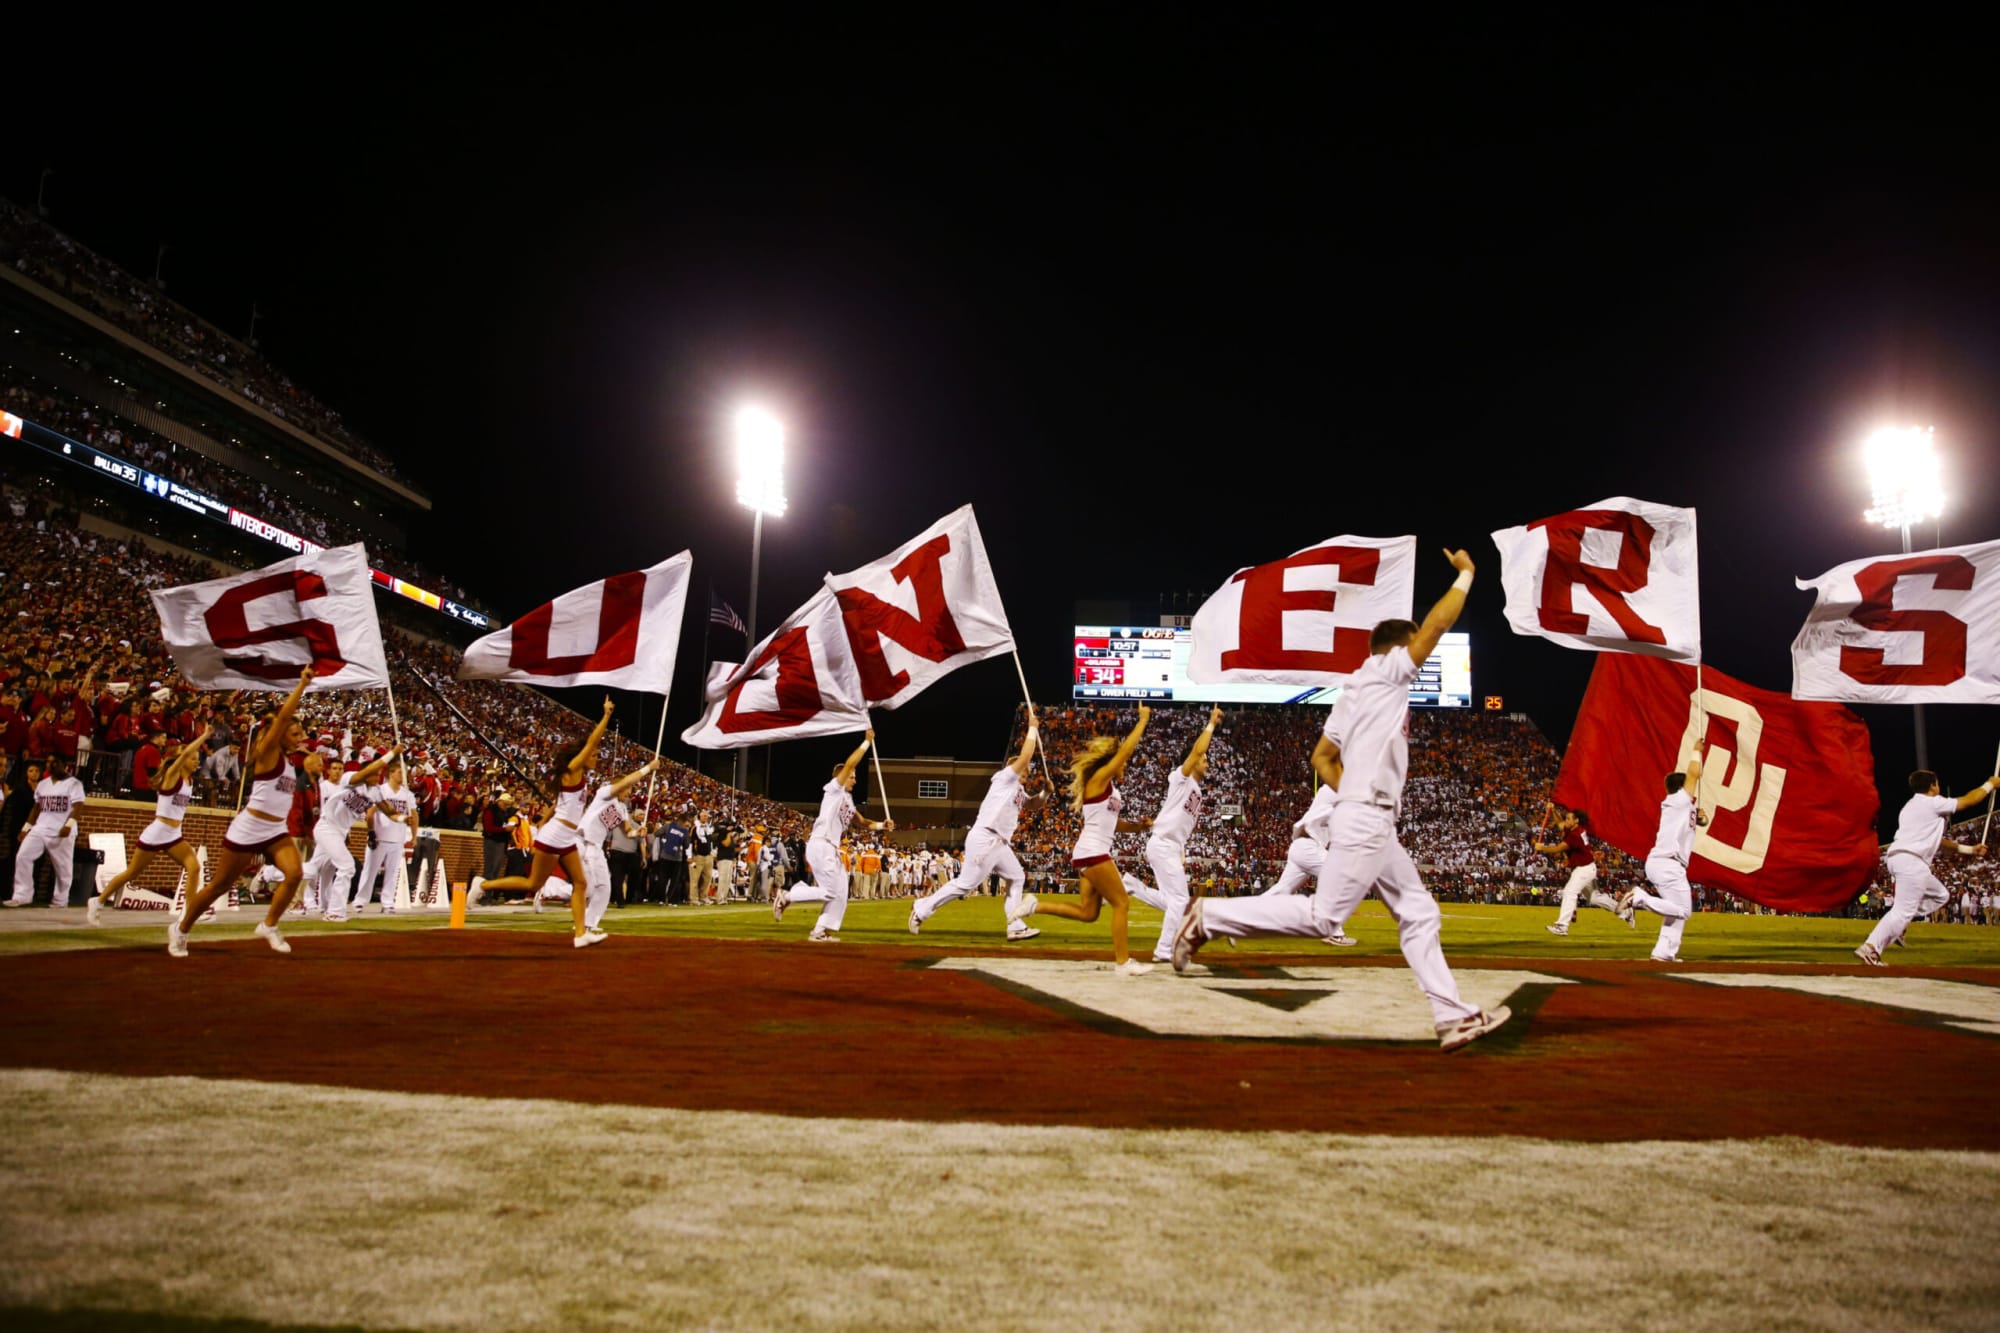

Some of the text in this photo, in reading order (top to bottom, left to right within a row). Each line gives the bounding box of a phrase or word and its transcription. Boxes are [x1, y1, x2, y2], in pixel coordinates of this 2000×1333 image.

[94, 456, 137, 481] BALL ON 35
[231, 510, 303, 552] INTERCEPTIONS
[1527, 509, 1667, 645] R
[204, 570, 346, 679] S
[836, 534, 968, 701] N
[1221, 545, 1380, 673] E
[1840, 554, 1976, 686] S
[1092, 669, 1115, 683] 34
[1101, 689, 1124, 697] OWEN
[1126, 689, 1147, 697] FIELD
[1487, 697, 1501, 709] 25
[121, 898, 170, 912] SOONER
